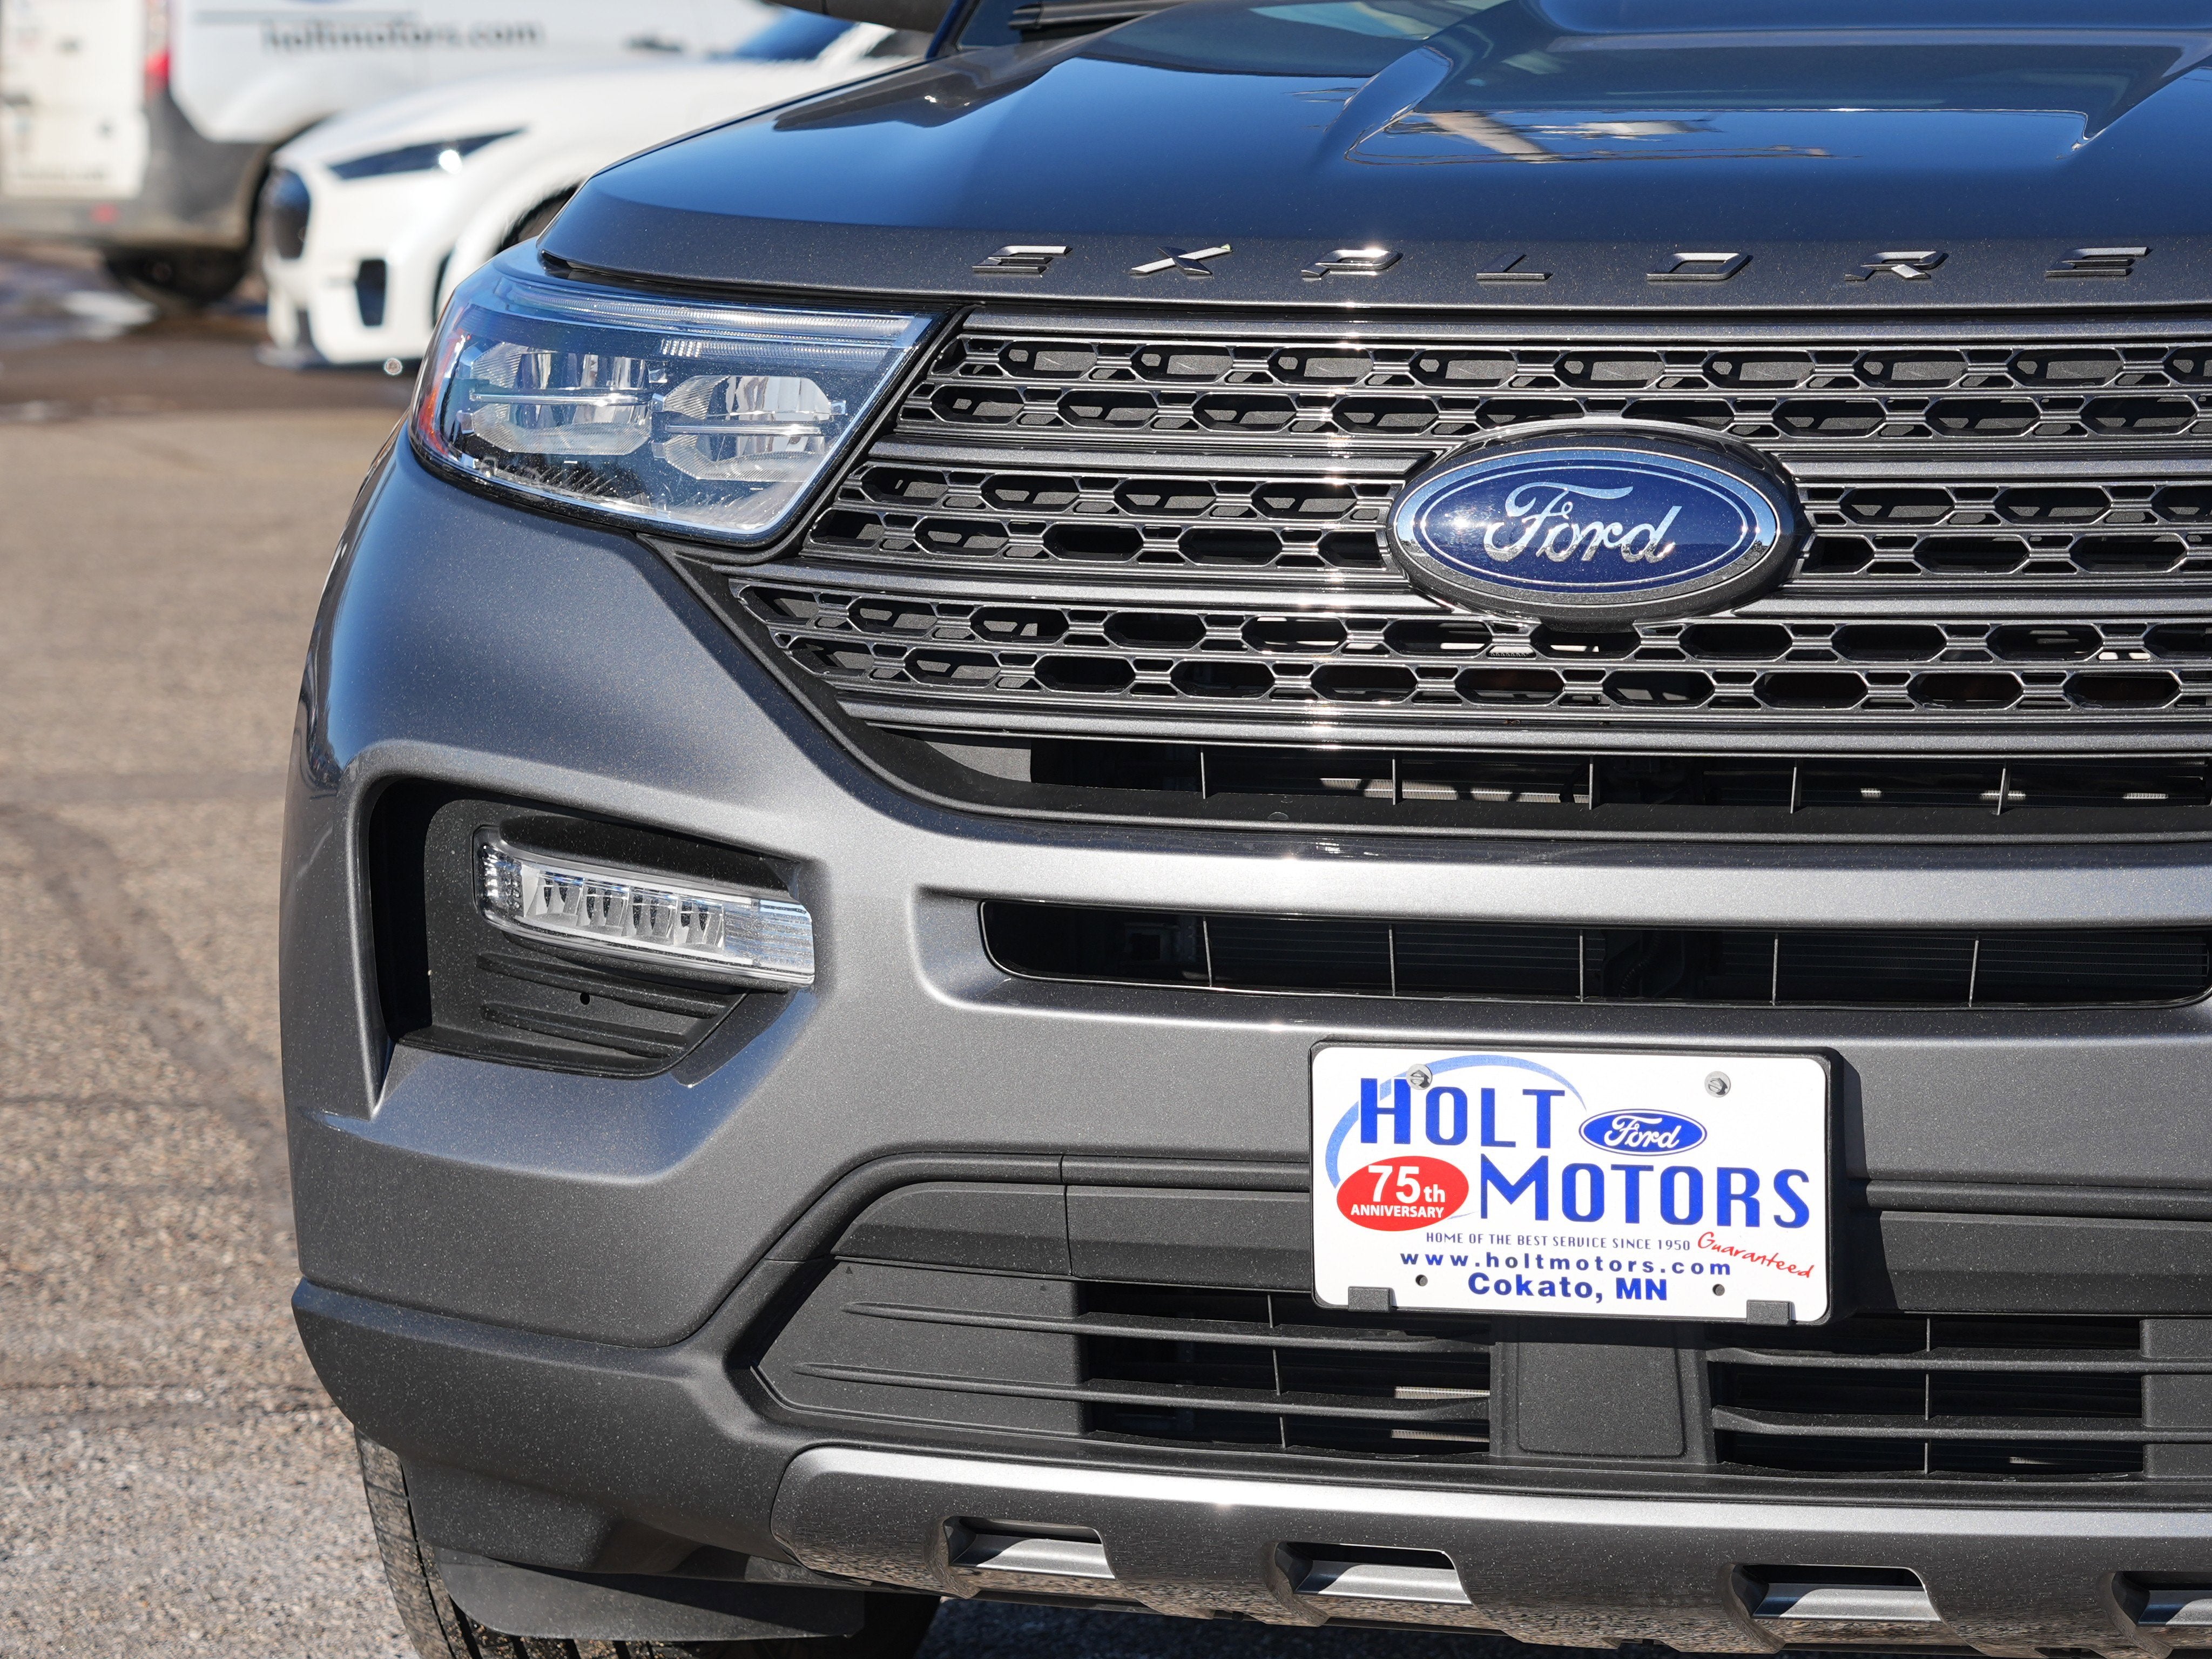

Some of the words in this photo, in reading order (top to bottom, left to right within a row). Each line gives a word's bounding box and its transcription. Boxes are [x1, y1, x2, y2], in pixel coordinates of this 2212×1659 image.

[1482, 481, 1682, 563] Ford
[1360, 1077, 1565, 1149] HOLT
[1603, 1115, 1682, 1149] Ford
[1367, 1164, 1446, 1204] 75th
[1480, 1153, 1810, 1229] MOTORS
[1350, 1204, 1445, 1218] ANNIVERSARY
[1426, 1232, 1463, 1244] HOME
[1468, 1233, 1484, 1244] OF
[1488, 1234, 1512, 1245] THE
[1517, 1235, 1548, 1246] BEST
[1553, 1236, 1607, 1249] SERVICE
[1612, 1238, 1651, 1250] SINCE
[1658, 1239, 1690, 1251] 1950
[1697, 1231, 1815, 1278] Guaranteed
[1400, 1251, 1731, 1276] www.holtmotors.com
[1468, 1272, 1603, 1304] Cokato,
[1615, 1277, 1667, 1301] MN
